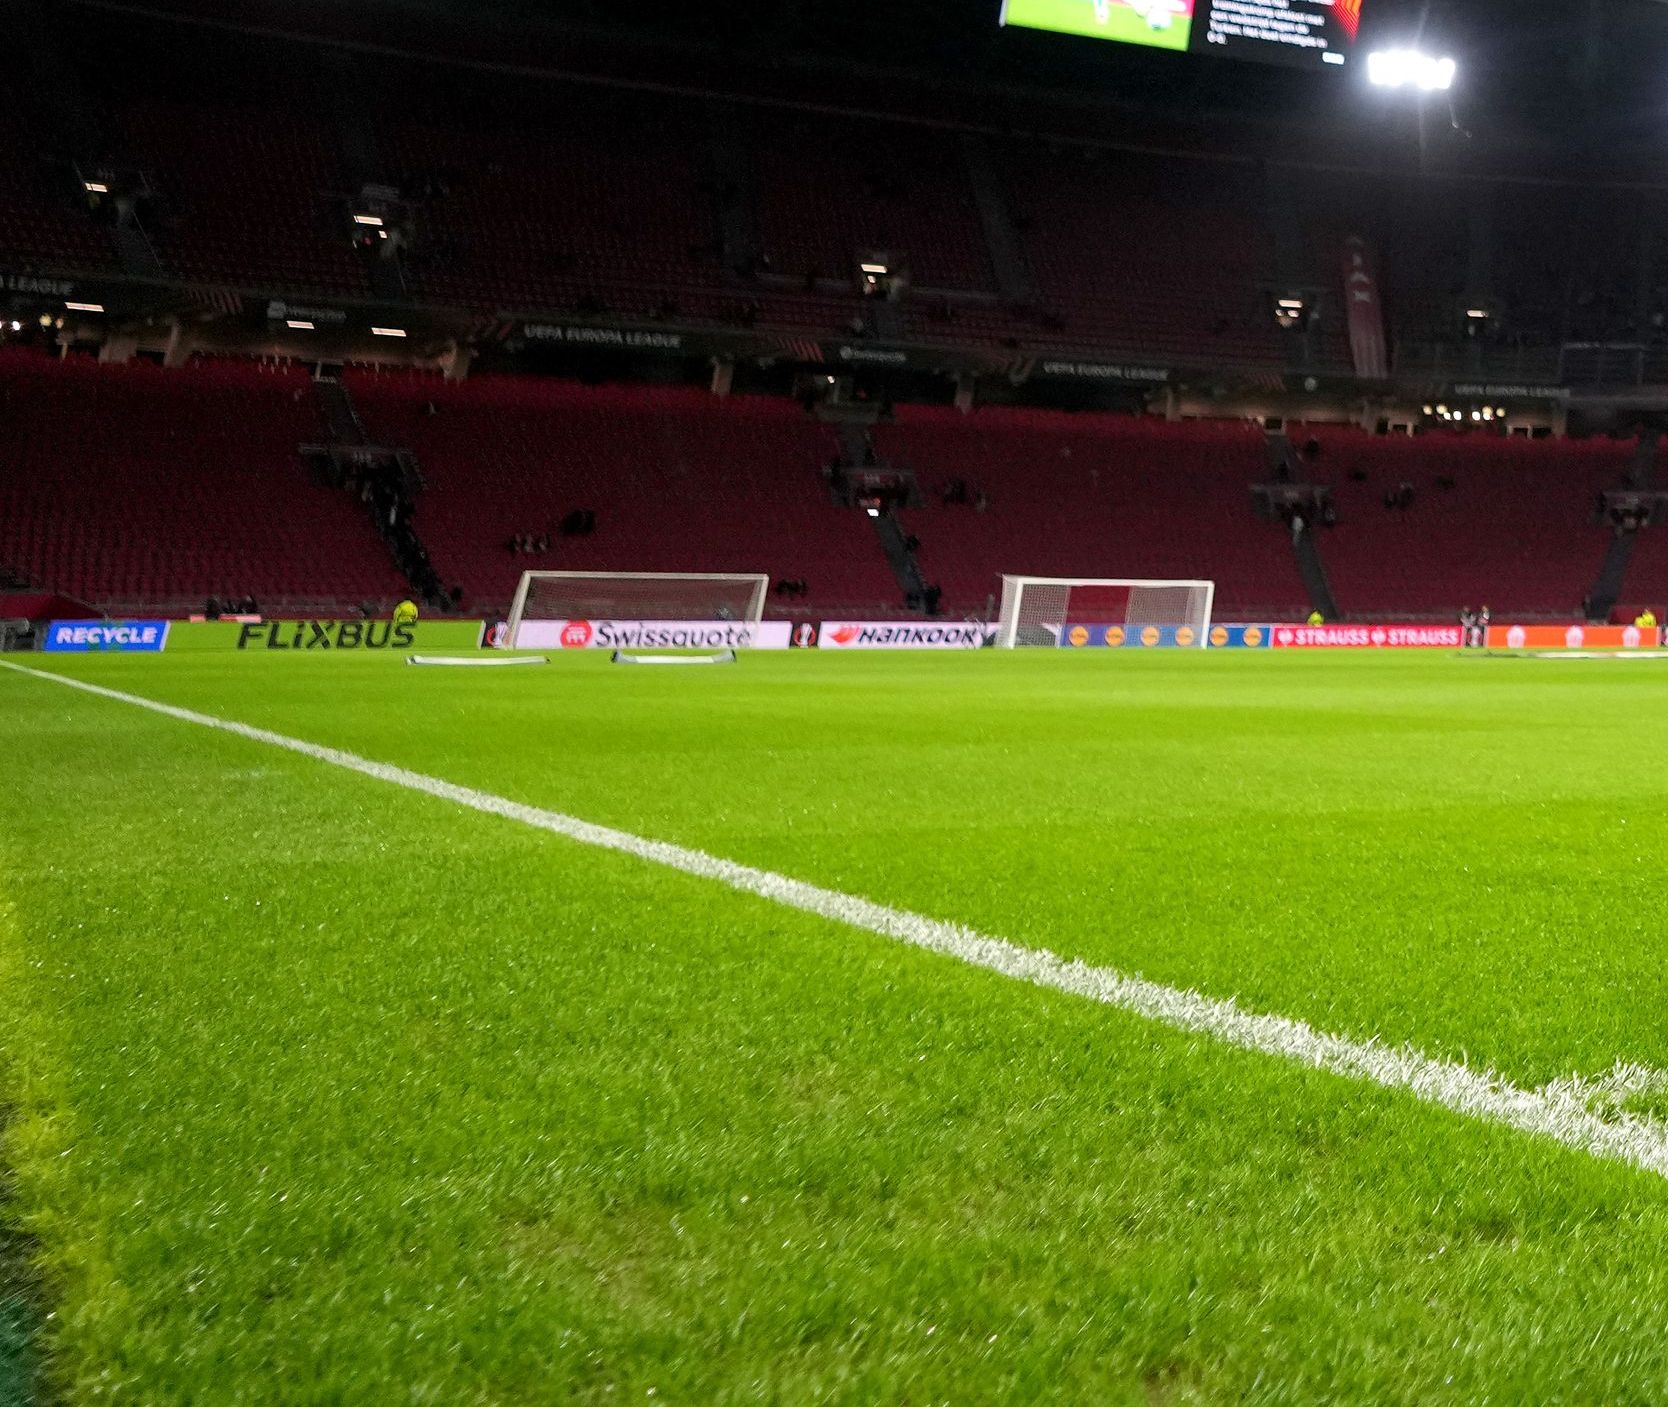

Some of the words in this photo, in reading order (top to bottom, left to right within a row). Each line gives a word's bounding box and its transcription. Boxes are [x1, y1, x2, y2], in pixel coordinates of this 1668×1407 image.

[55, 626, 158, 644] RECYCLE
[594, 621, 752, 648] Swissquote
[1294, 628, 1369, 646] STRAUSS
[1388, 628, 1458, 646] STRAUSS
